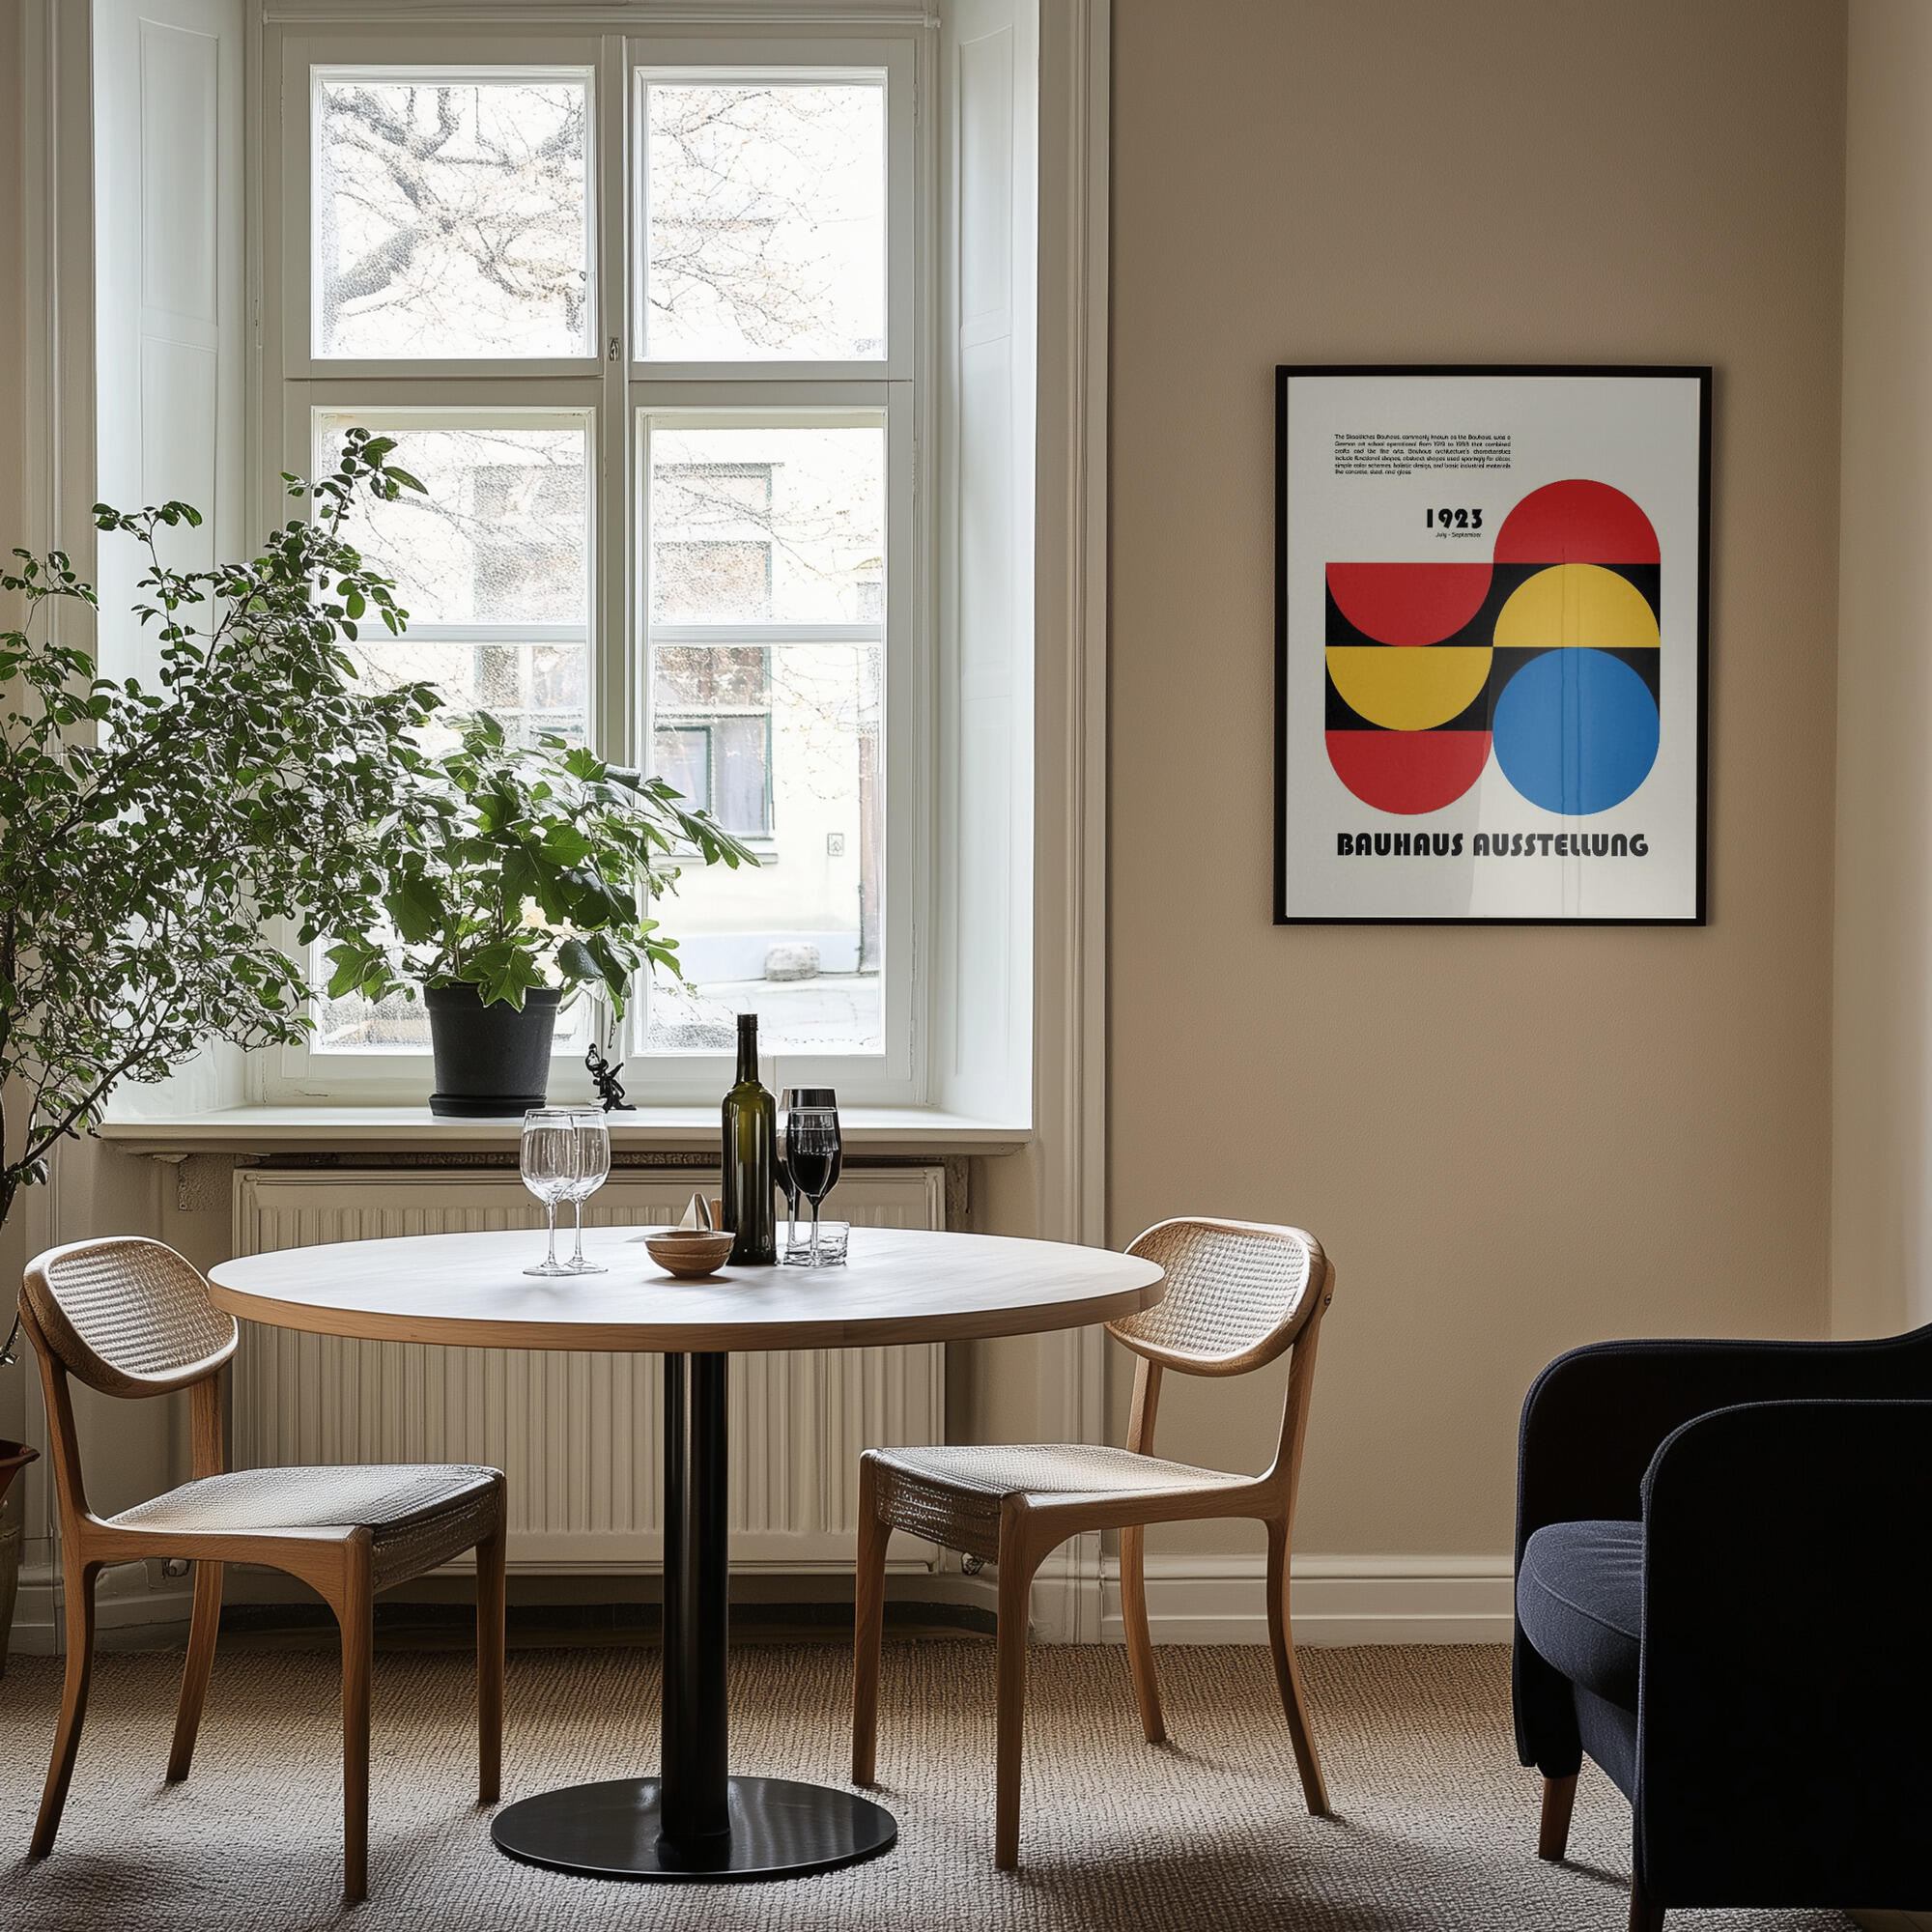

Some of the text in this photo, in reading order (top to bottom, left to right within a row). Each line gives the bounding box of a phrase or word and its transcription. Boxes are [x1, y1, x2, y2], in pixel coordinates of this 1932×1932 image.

[1427, 508, 1483, 529] 1923
[1337, 833, 1649, 856] BAUHAUS AUSSTELLUNG
